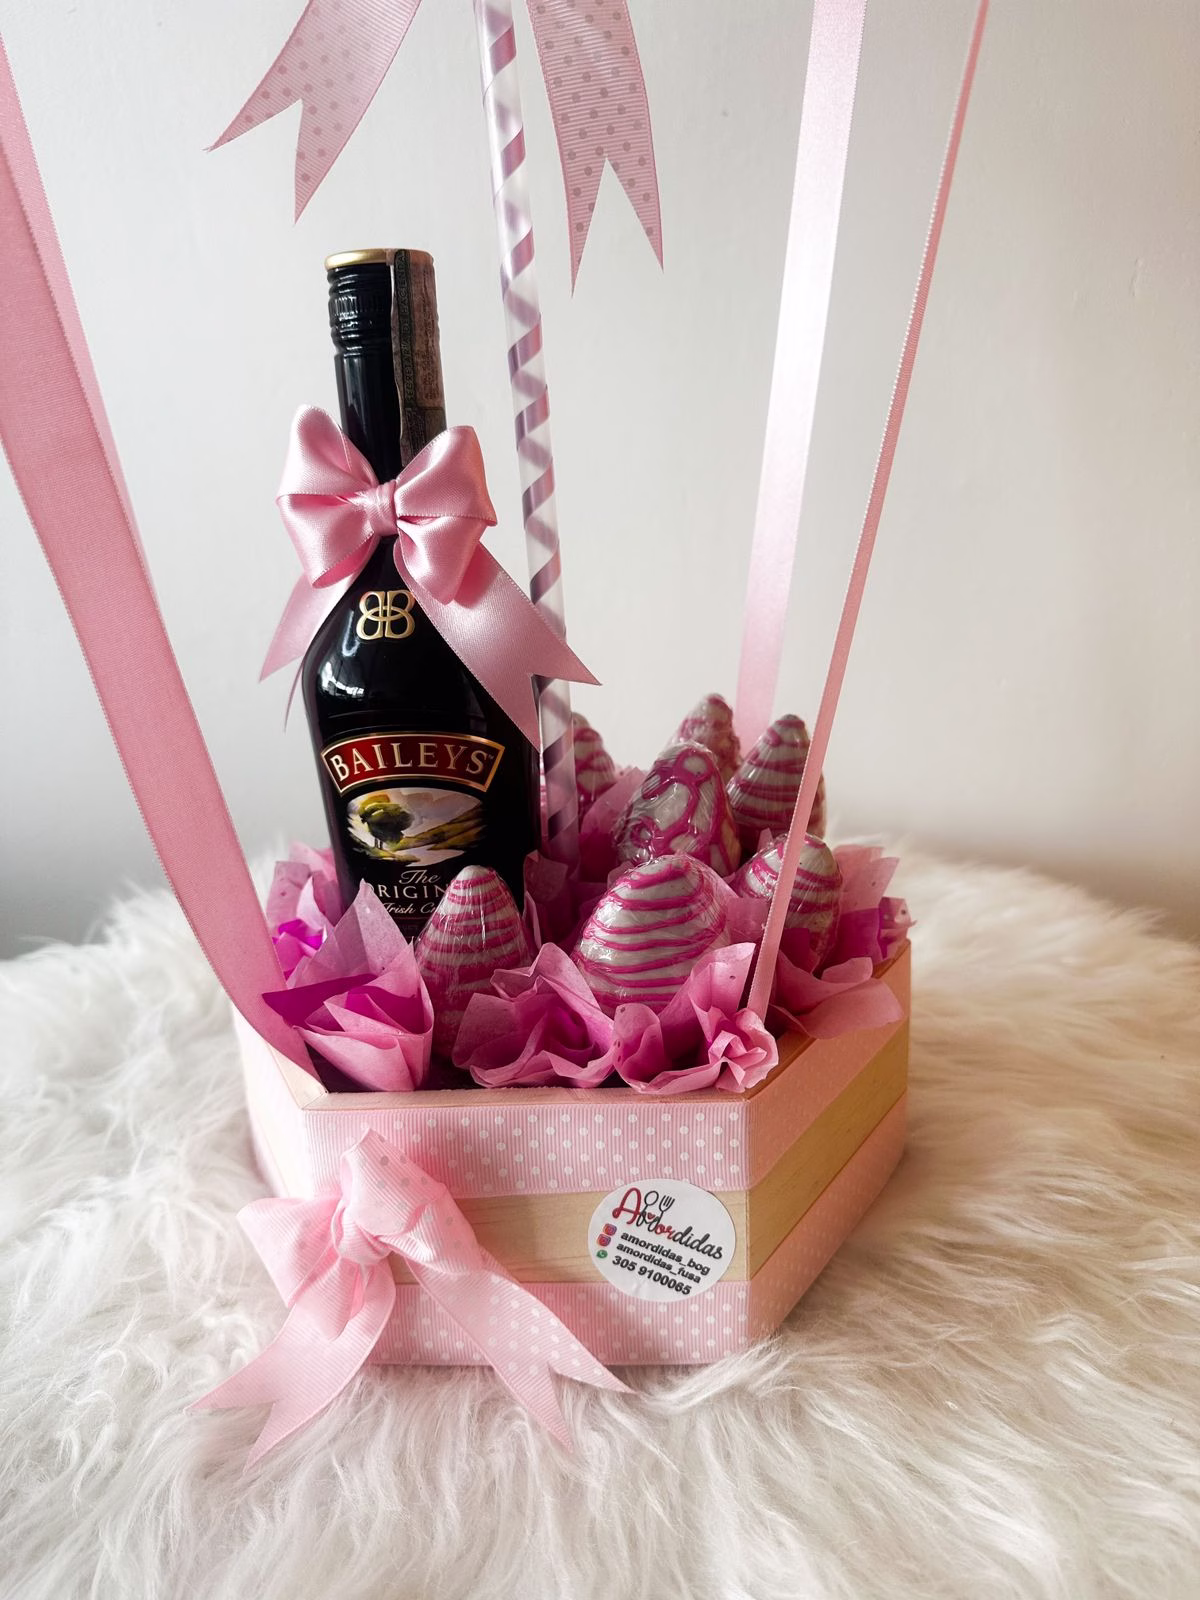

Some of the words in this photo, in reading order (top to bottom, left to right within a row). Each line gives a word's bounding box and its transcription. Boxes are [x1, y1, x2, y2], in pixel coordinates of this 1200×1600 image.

[330, 742, 490, 781] BAILEYS
[399, 869, 442, 885] The
[612, 1187, 723, 1260] Amordidas
[616, 1243, 701, 1282] amordidas_fusa
[620, 1232, 710, 1275] amordidas_bog
[612, 1255, 638, 1272] 305
[638, 1265, 691, 1294] 9100065
